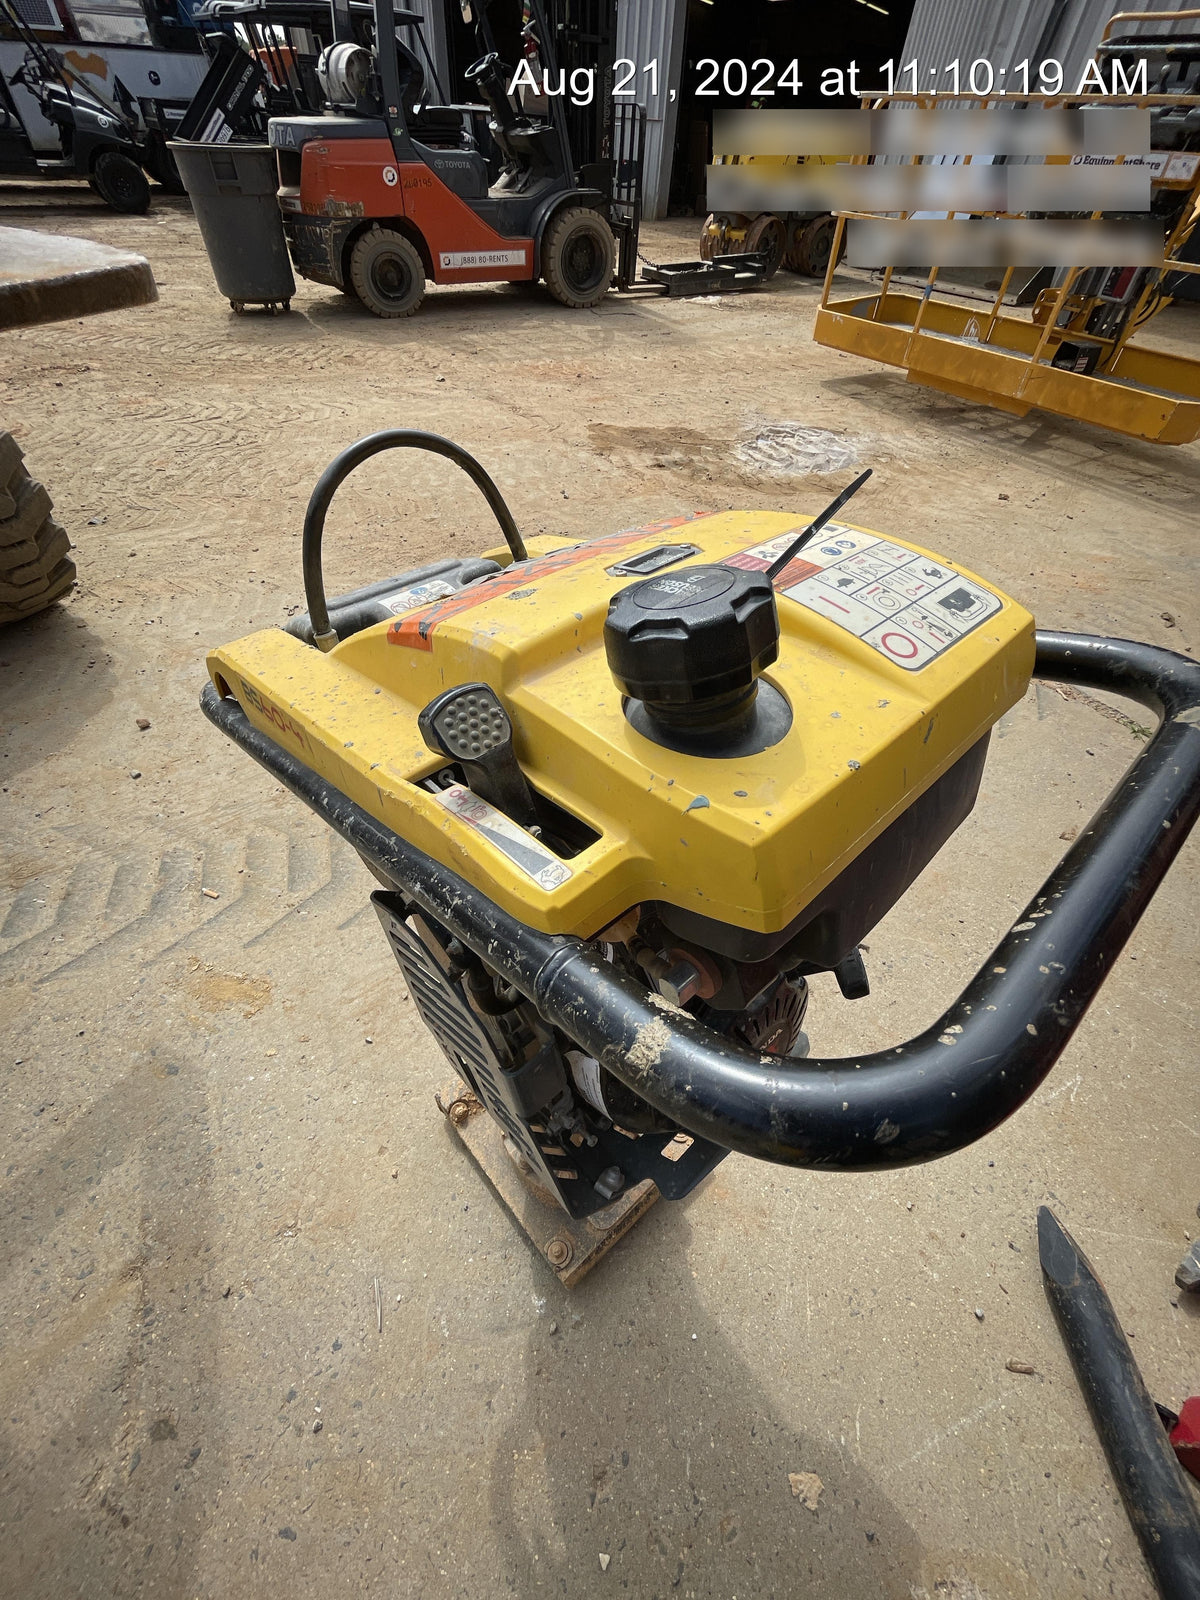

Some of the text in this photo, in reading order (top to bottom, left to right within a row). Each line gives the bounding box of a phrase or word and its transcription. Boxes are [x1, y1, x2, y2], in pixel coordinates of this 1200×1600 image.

[443, 160, 471, 169] TOYOTA
[460, 254, 509, 267] (888) 80-RENTS
[760, 1028, 784, 1051] NDA
